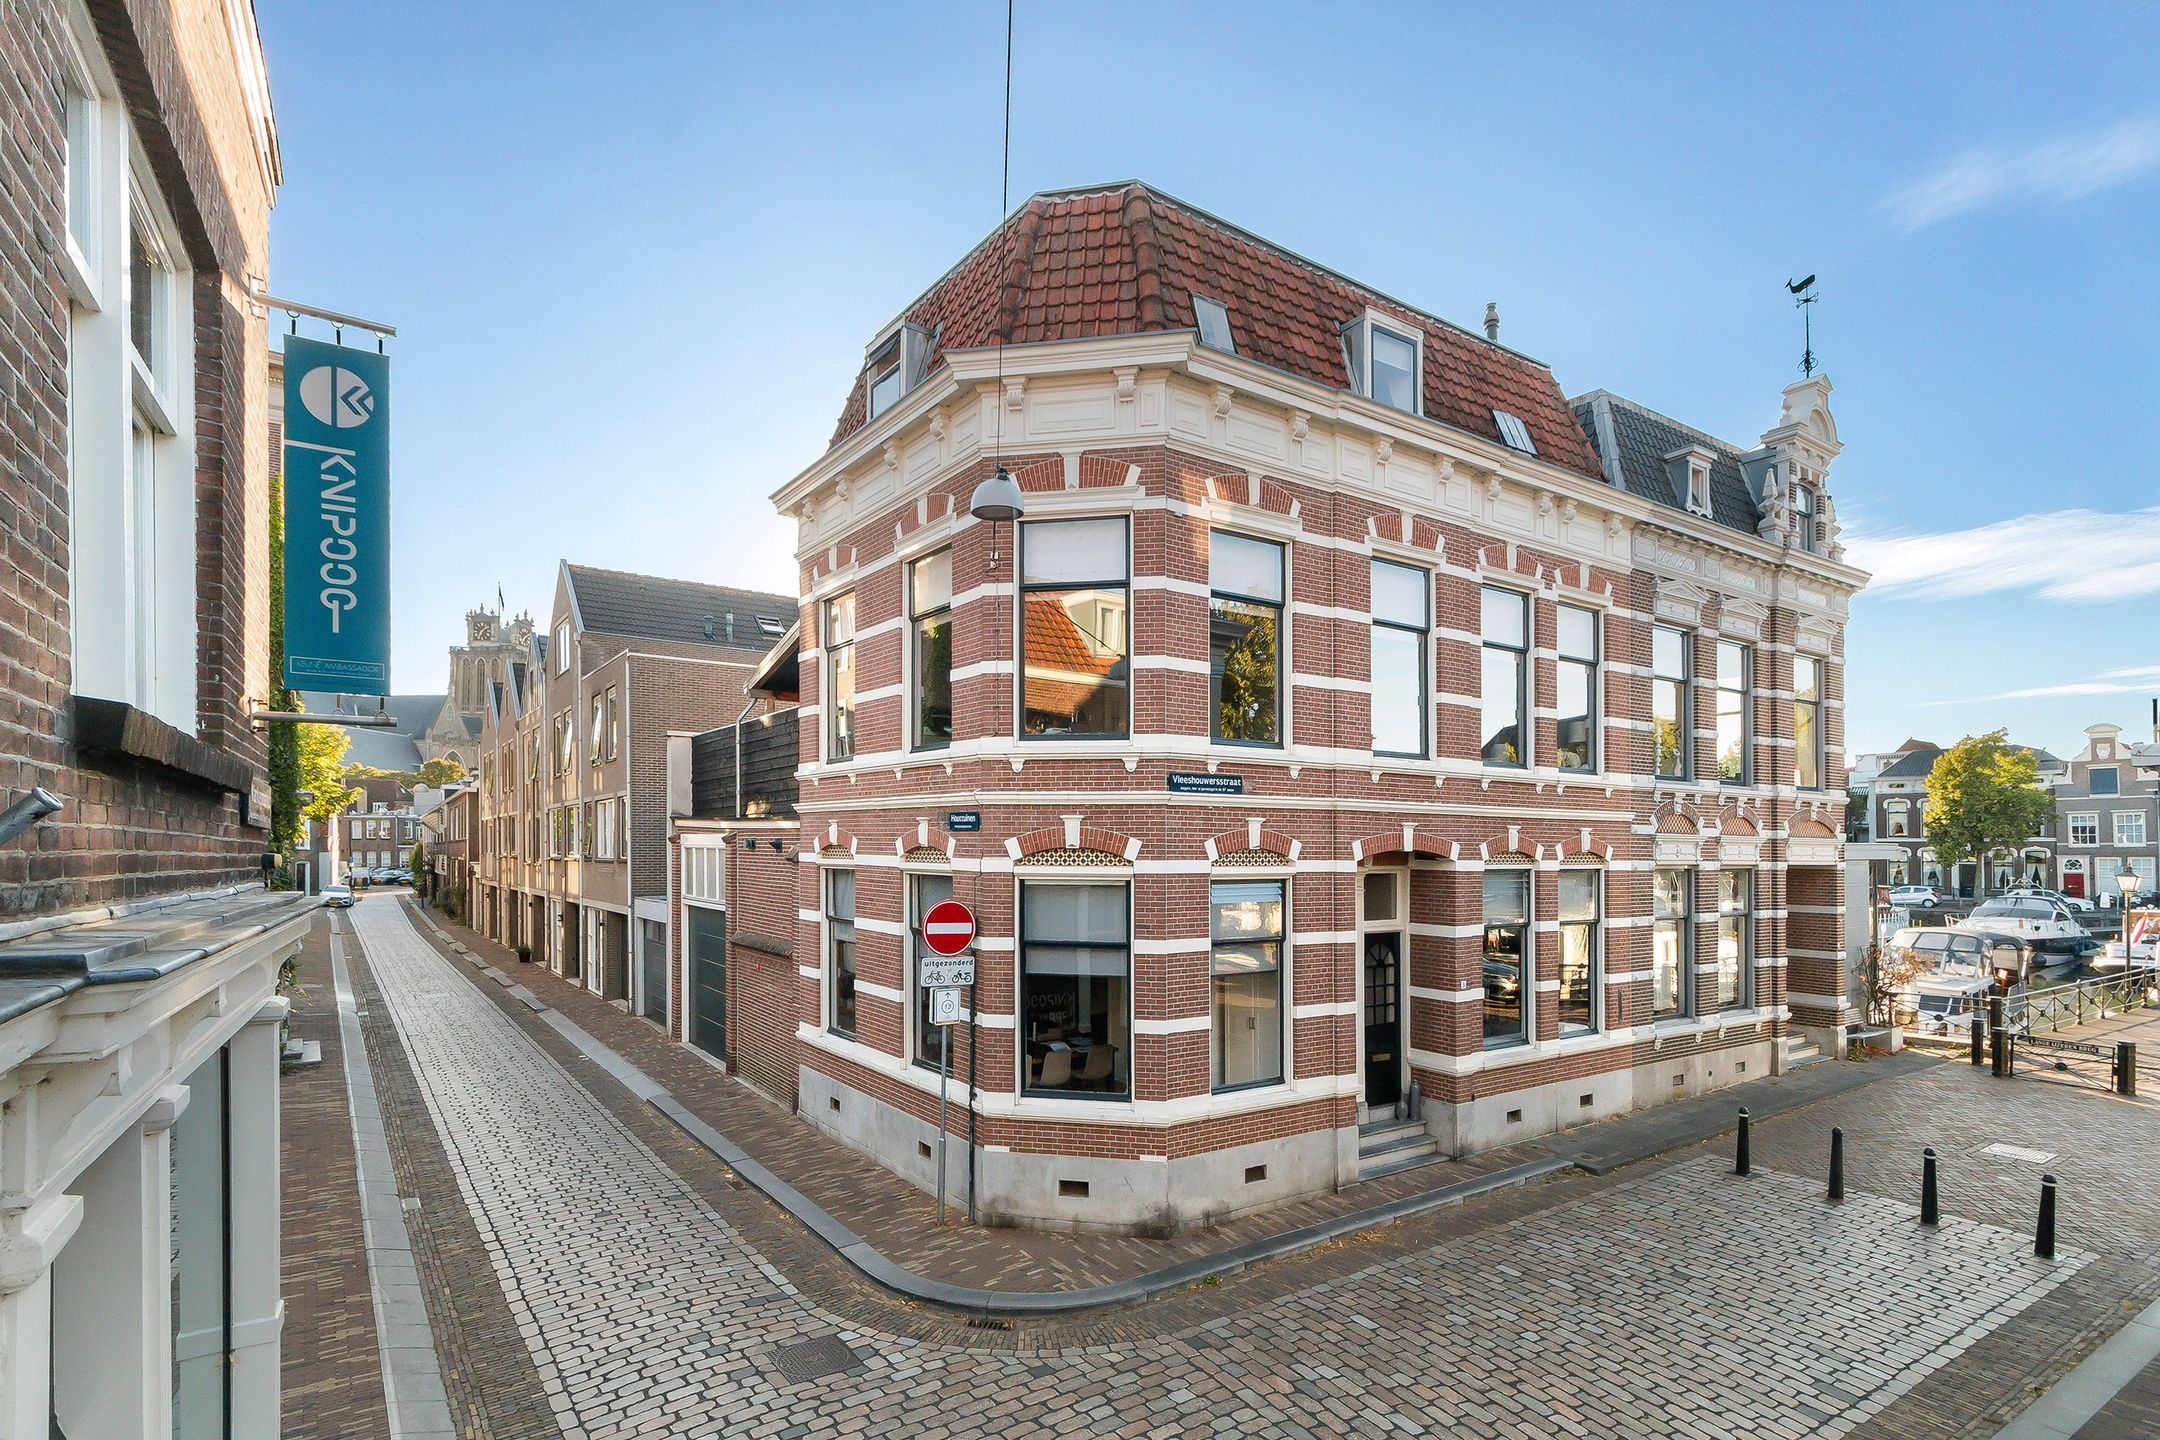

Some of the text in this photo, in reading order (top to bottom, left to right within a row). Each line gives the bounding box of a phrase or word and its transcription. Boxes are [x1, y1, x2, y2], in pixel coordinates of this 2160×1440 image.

[323, 662, 380, 673] AMBASSADOR
[1172, 774, 1241, 786] Vleeshouwersstraat
[950, 813, 976, 822] Houttuinen
[924, 959, 973, 968] uitgezonderd
